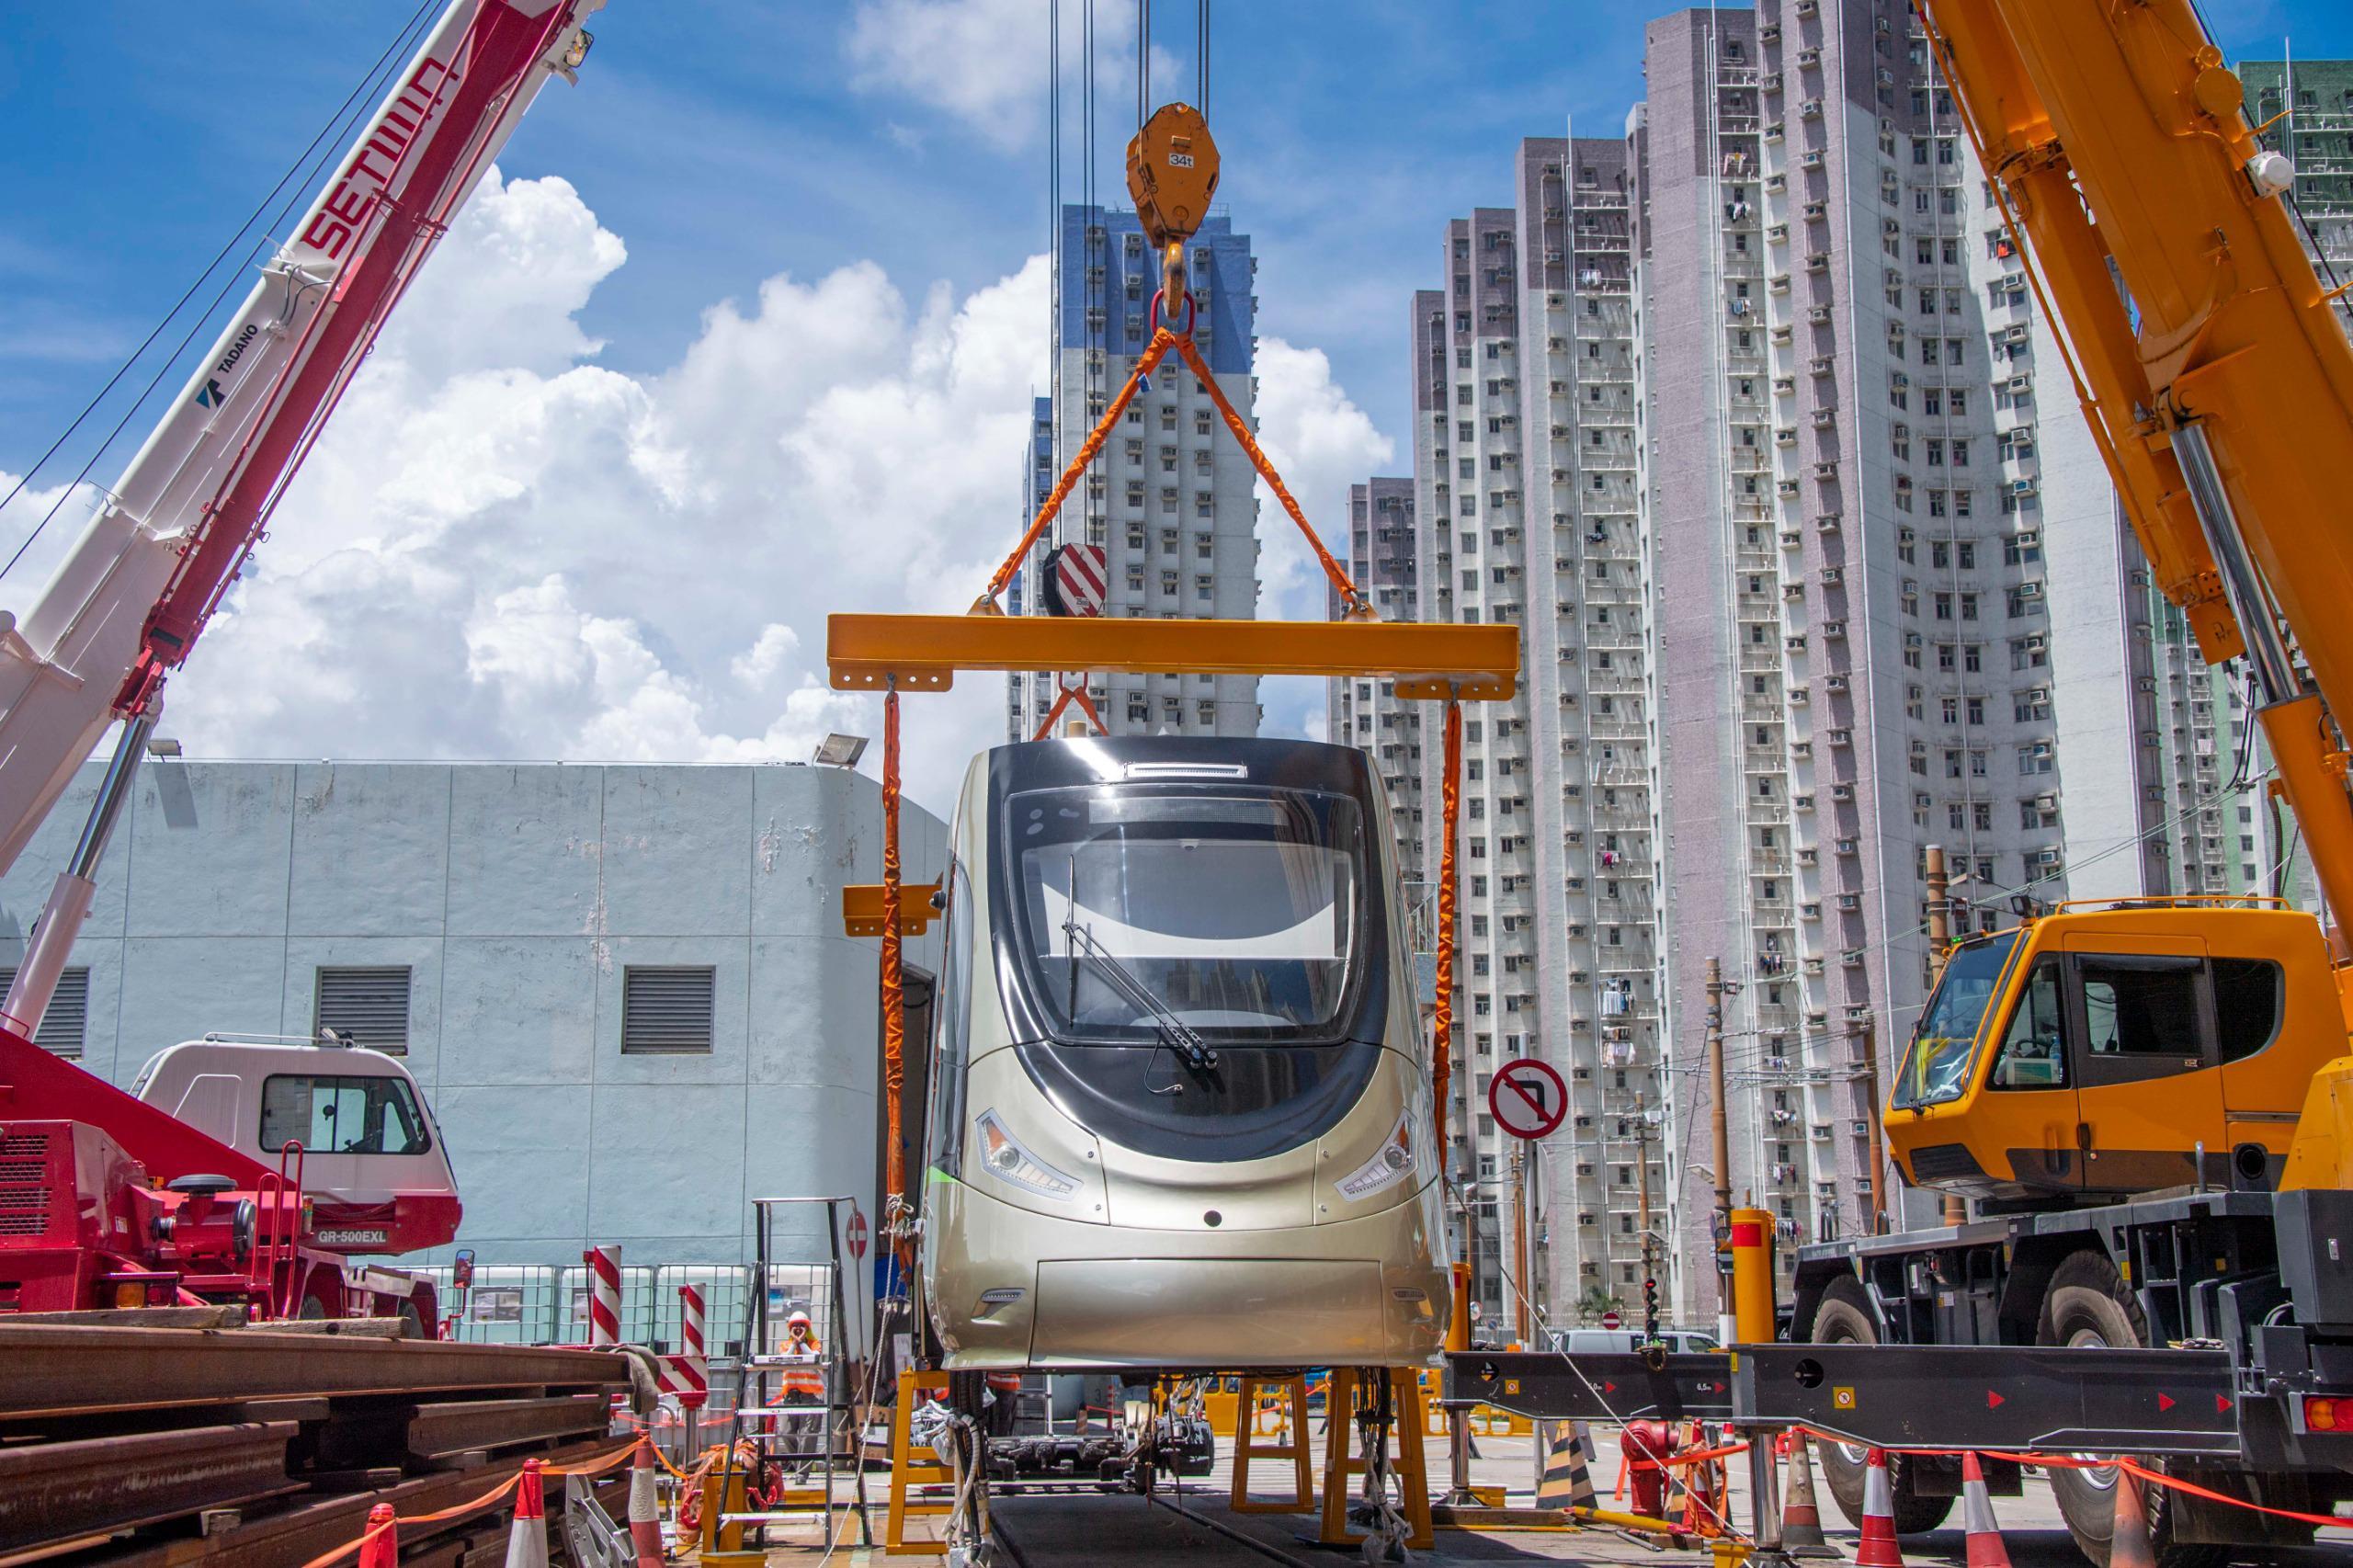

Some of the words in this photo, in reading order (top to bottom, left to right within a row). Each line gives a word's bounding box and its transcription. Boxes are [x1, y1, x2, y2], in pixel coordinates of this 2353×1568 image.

[301, 57, 460, 260] SETWIN
[1170, 154, 1192, 167] 34t
[217, 324, 258, 374] TADANO
[318, 1230, 386, 1243] GR-500EXL
